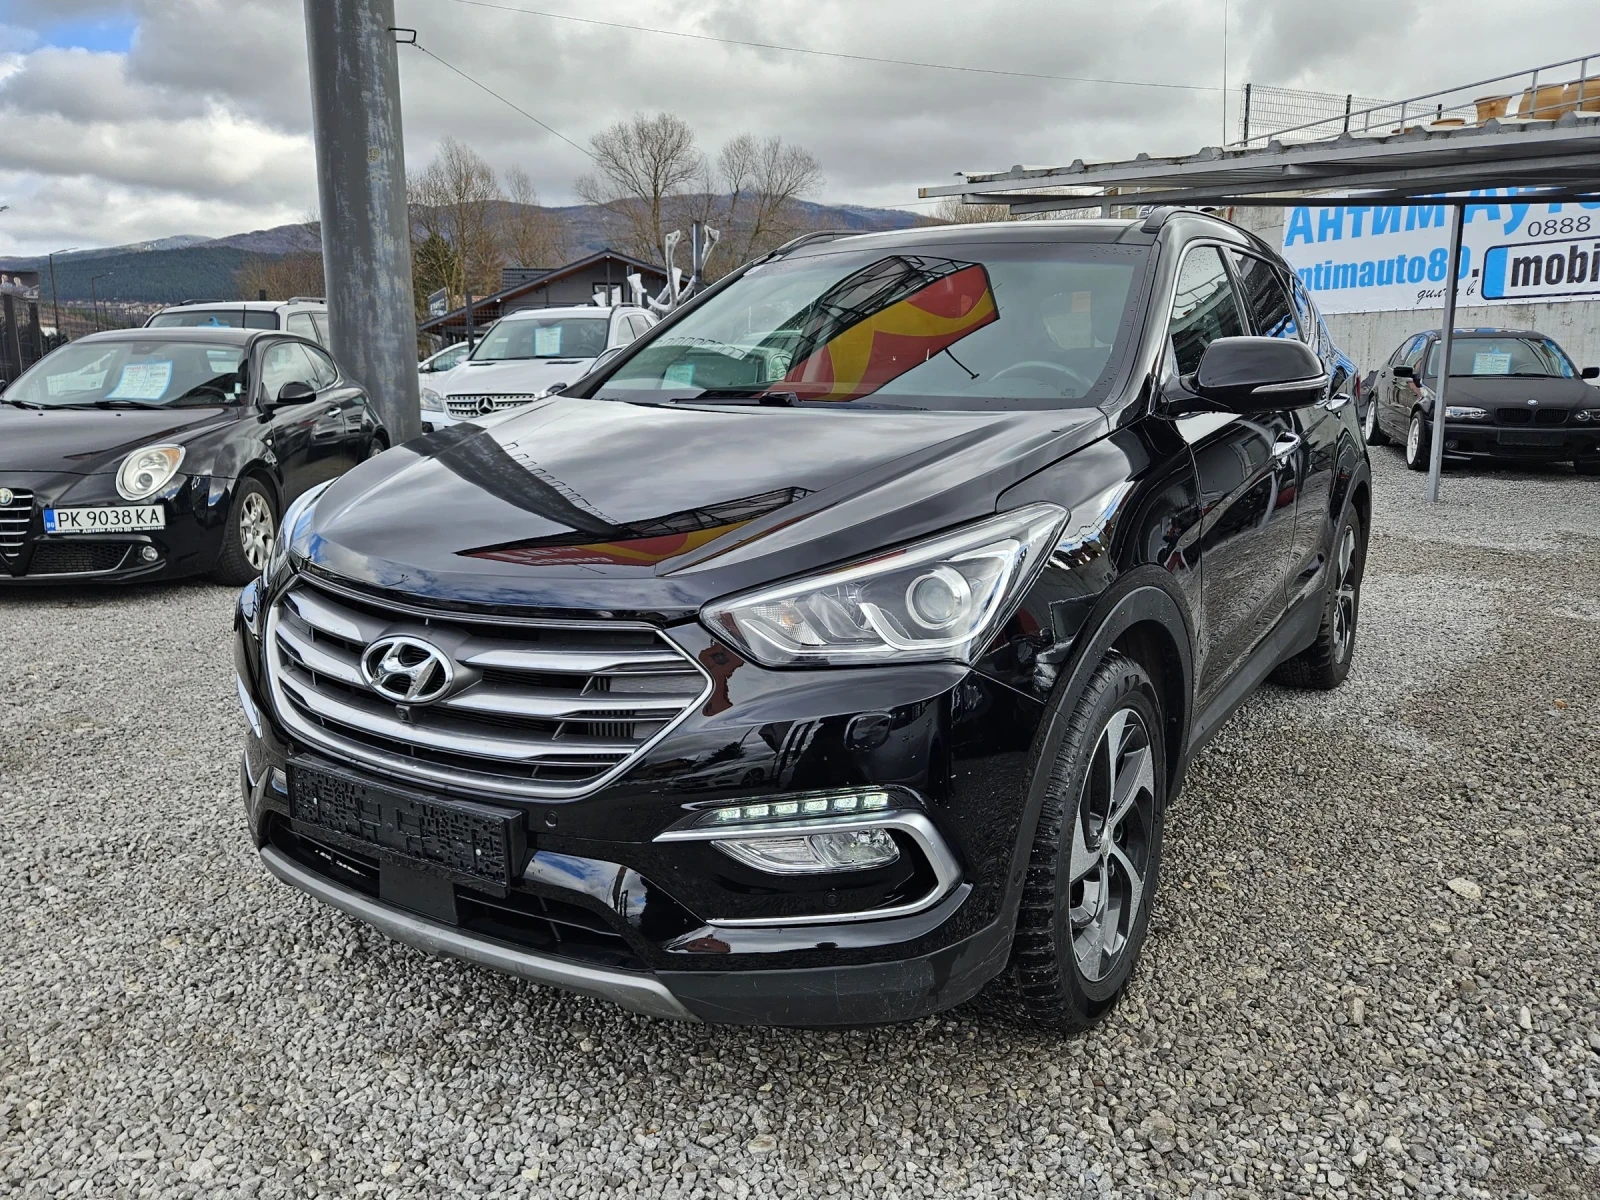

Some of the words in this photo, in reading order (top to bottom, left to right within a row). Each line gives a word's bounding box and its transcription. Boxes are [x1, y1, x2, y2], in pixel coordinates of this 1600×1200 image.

[1528, 215, 1591, 237] 0888
[57, 511, 82, 527] PK
[86, 510, 132, 526] 9038
[136, 508, 160, 524] KA
